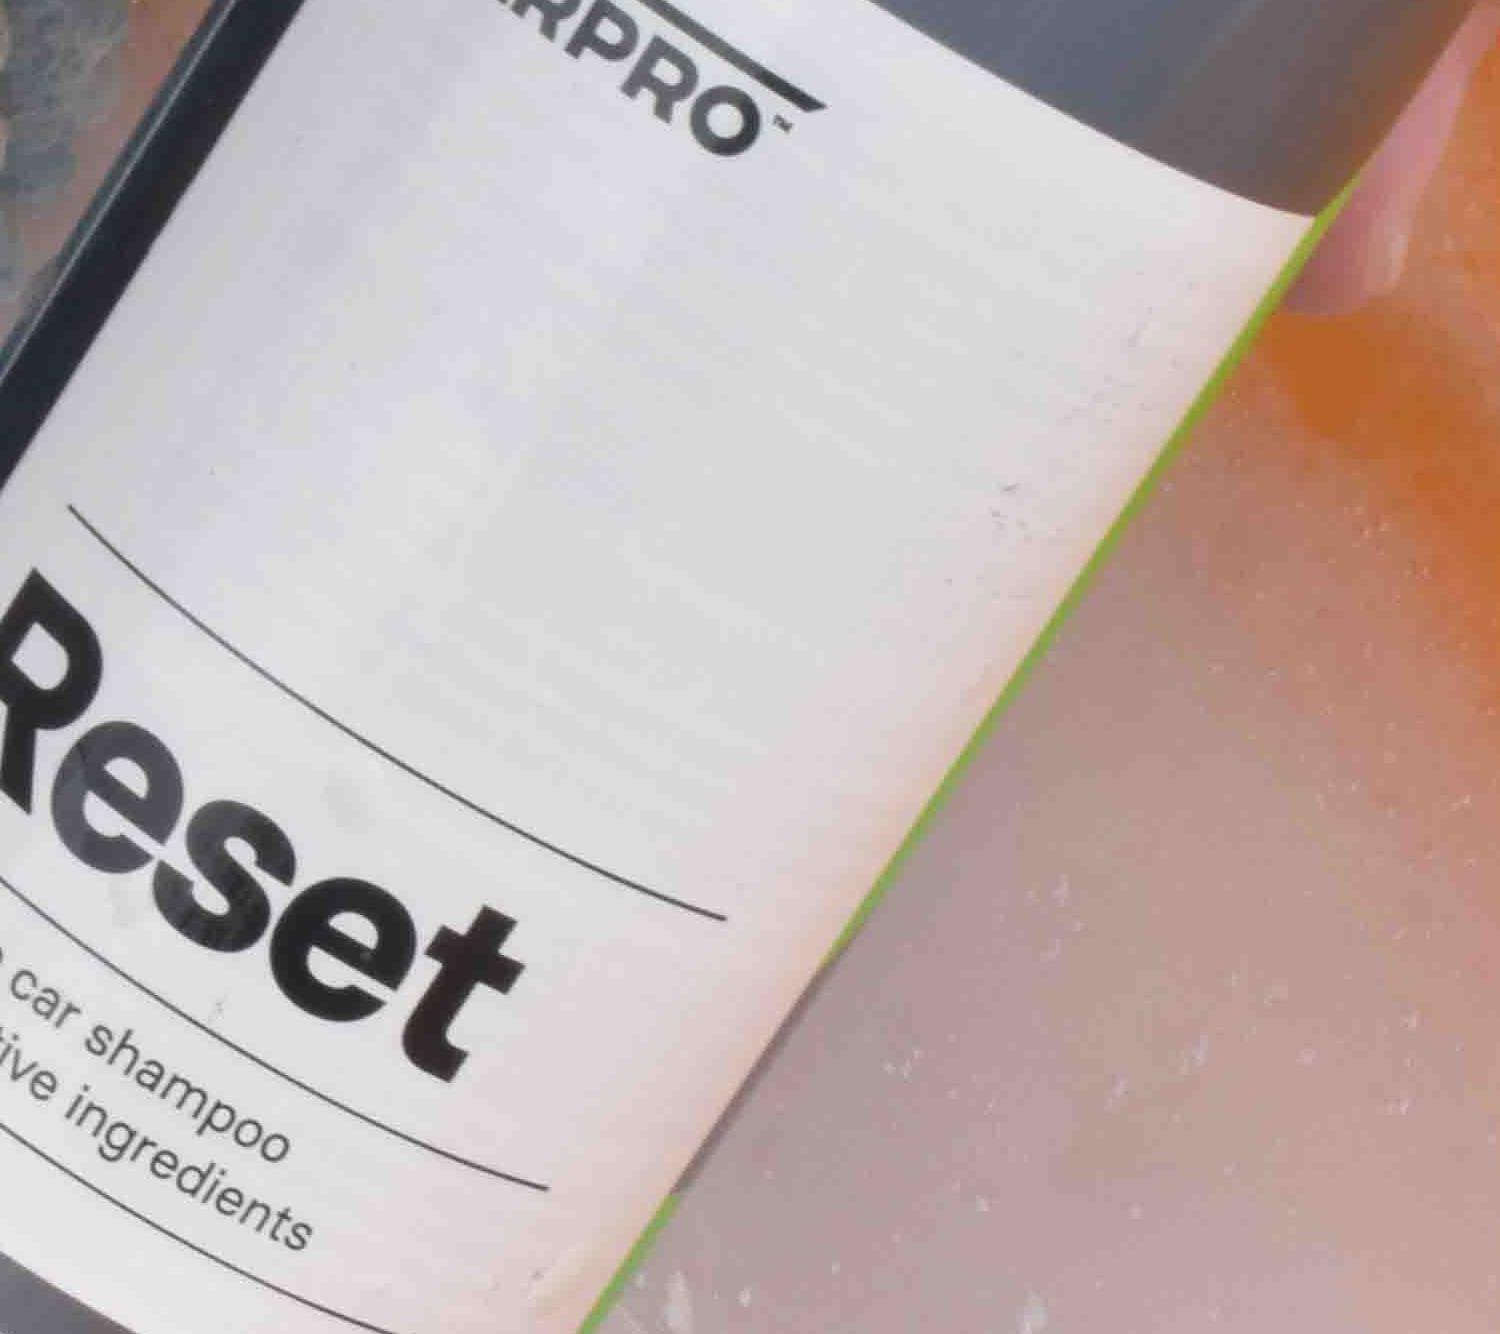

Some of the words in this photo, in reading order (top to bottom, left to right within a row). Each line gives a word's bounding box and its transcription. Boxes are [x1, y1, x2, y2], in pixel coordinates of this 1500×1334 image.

[10, 967, 81, 1030] car
[84, 1023, 291, 1164] shampoo
[65, 1084, 314, 1252] ingredients
